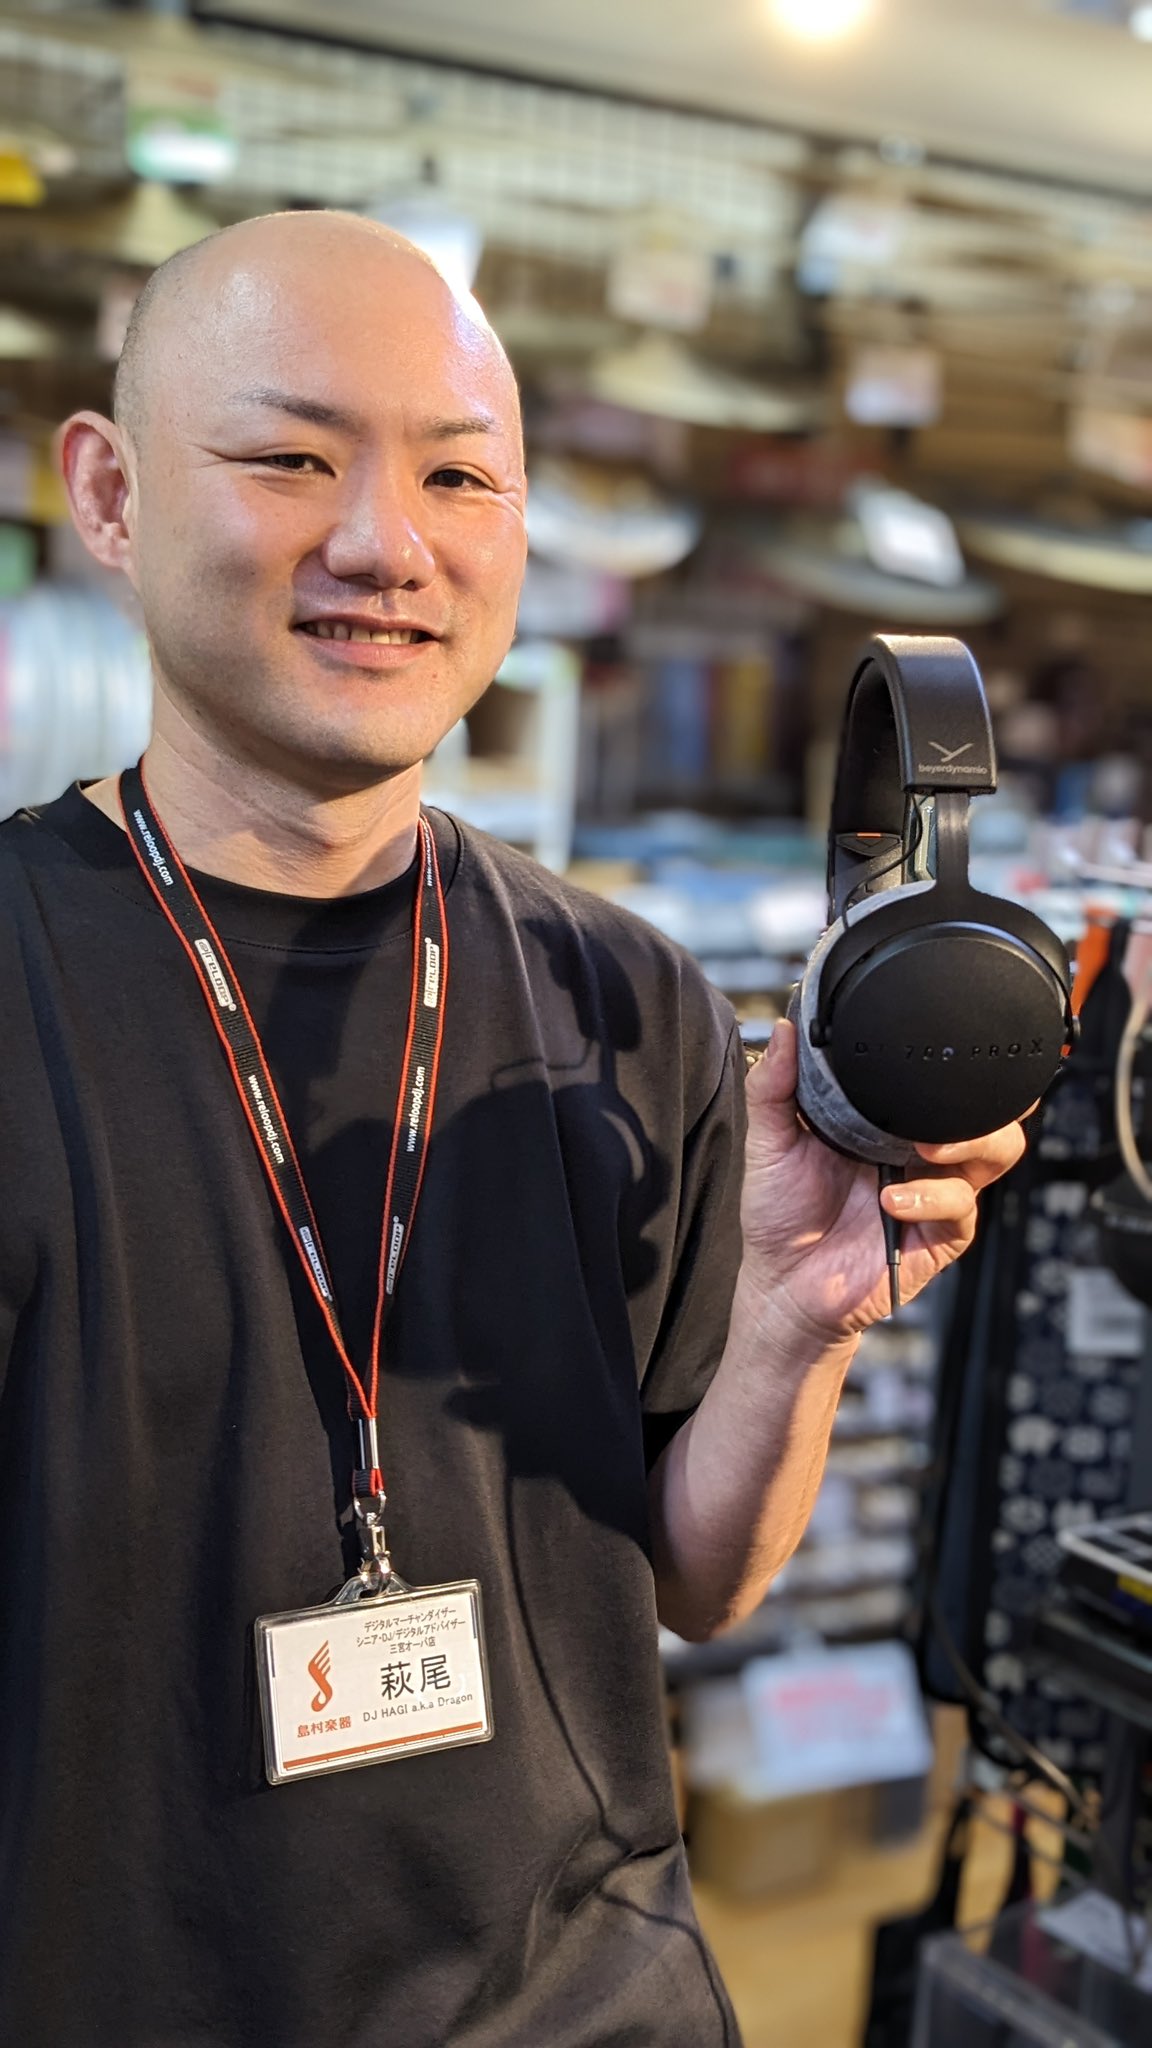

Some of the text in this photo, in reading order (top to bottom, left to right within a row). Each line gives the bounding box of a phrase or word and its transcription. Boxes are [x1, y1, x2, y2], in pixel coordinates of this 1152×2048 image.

[918, 764, 988, 774] beyerdynamic
[133, 809, 174, 886] www.reloopdj.com
[248, 1074, 284, 1164] www.reloopdj.com
[406, 1066, 426, 1152] www.reloopdj.com
[364, 1608, 456, 1632] デジタルマーチャンダイザー
[380, 1654, 451, 1701] 萩尾
[363, 1692, 473, 1722] DJ HAGI a.k.a Dragon
[297, 1716, 351, 1738] 島村楽器
